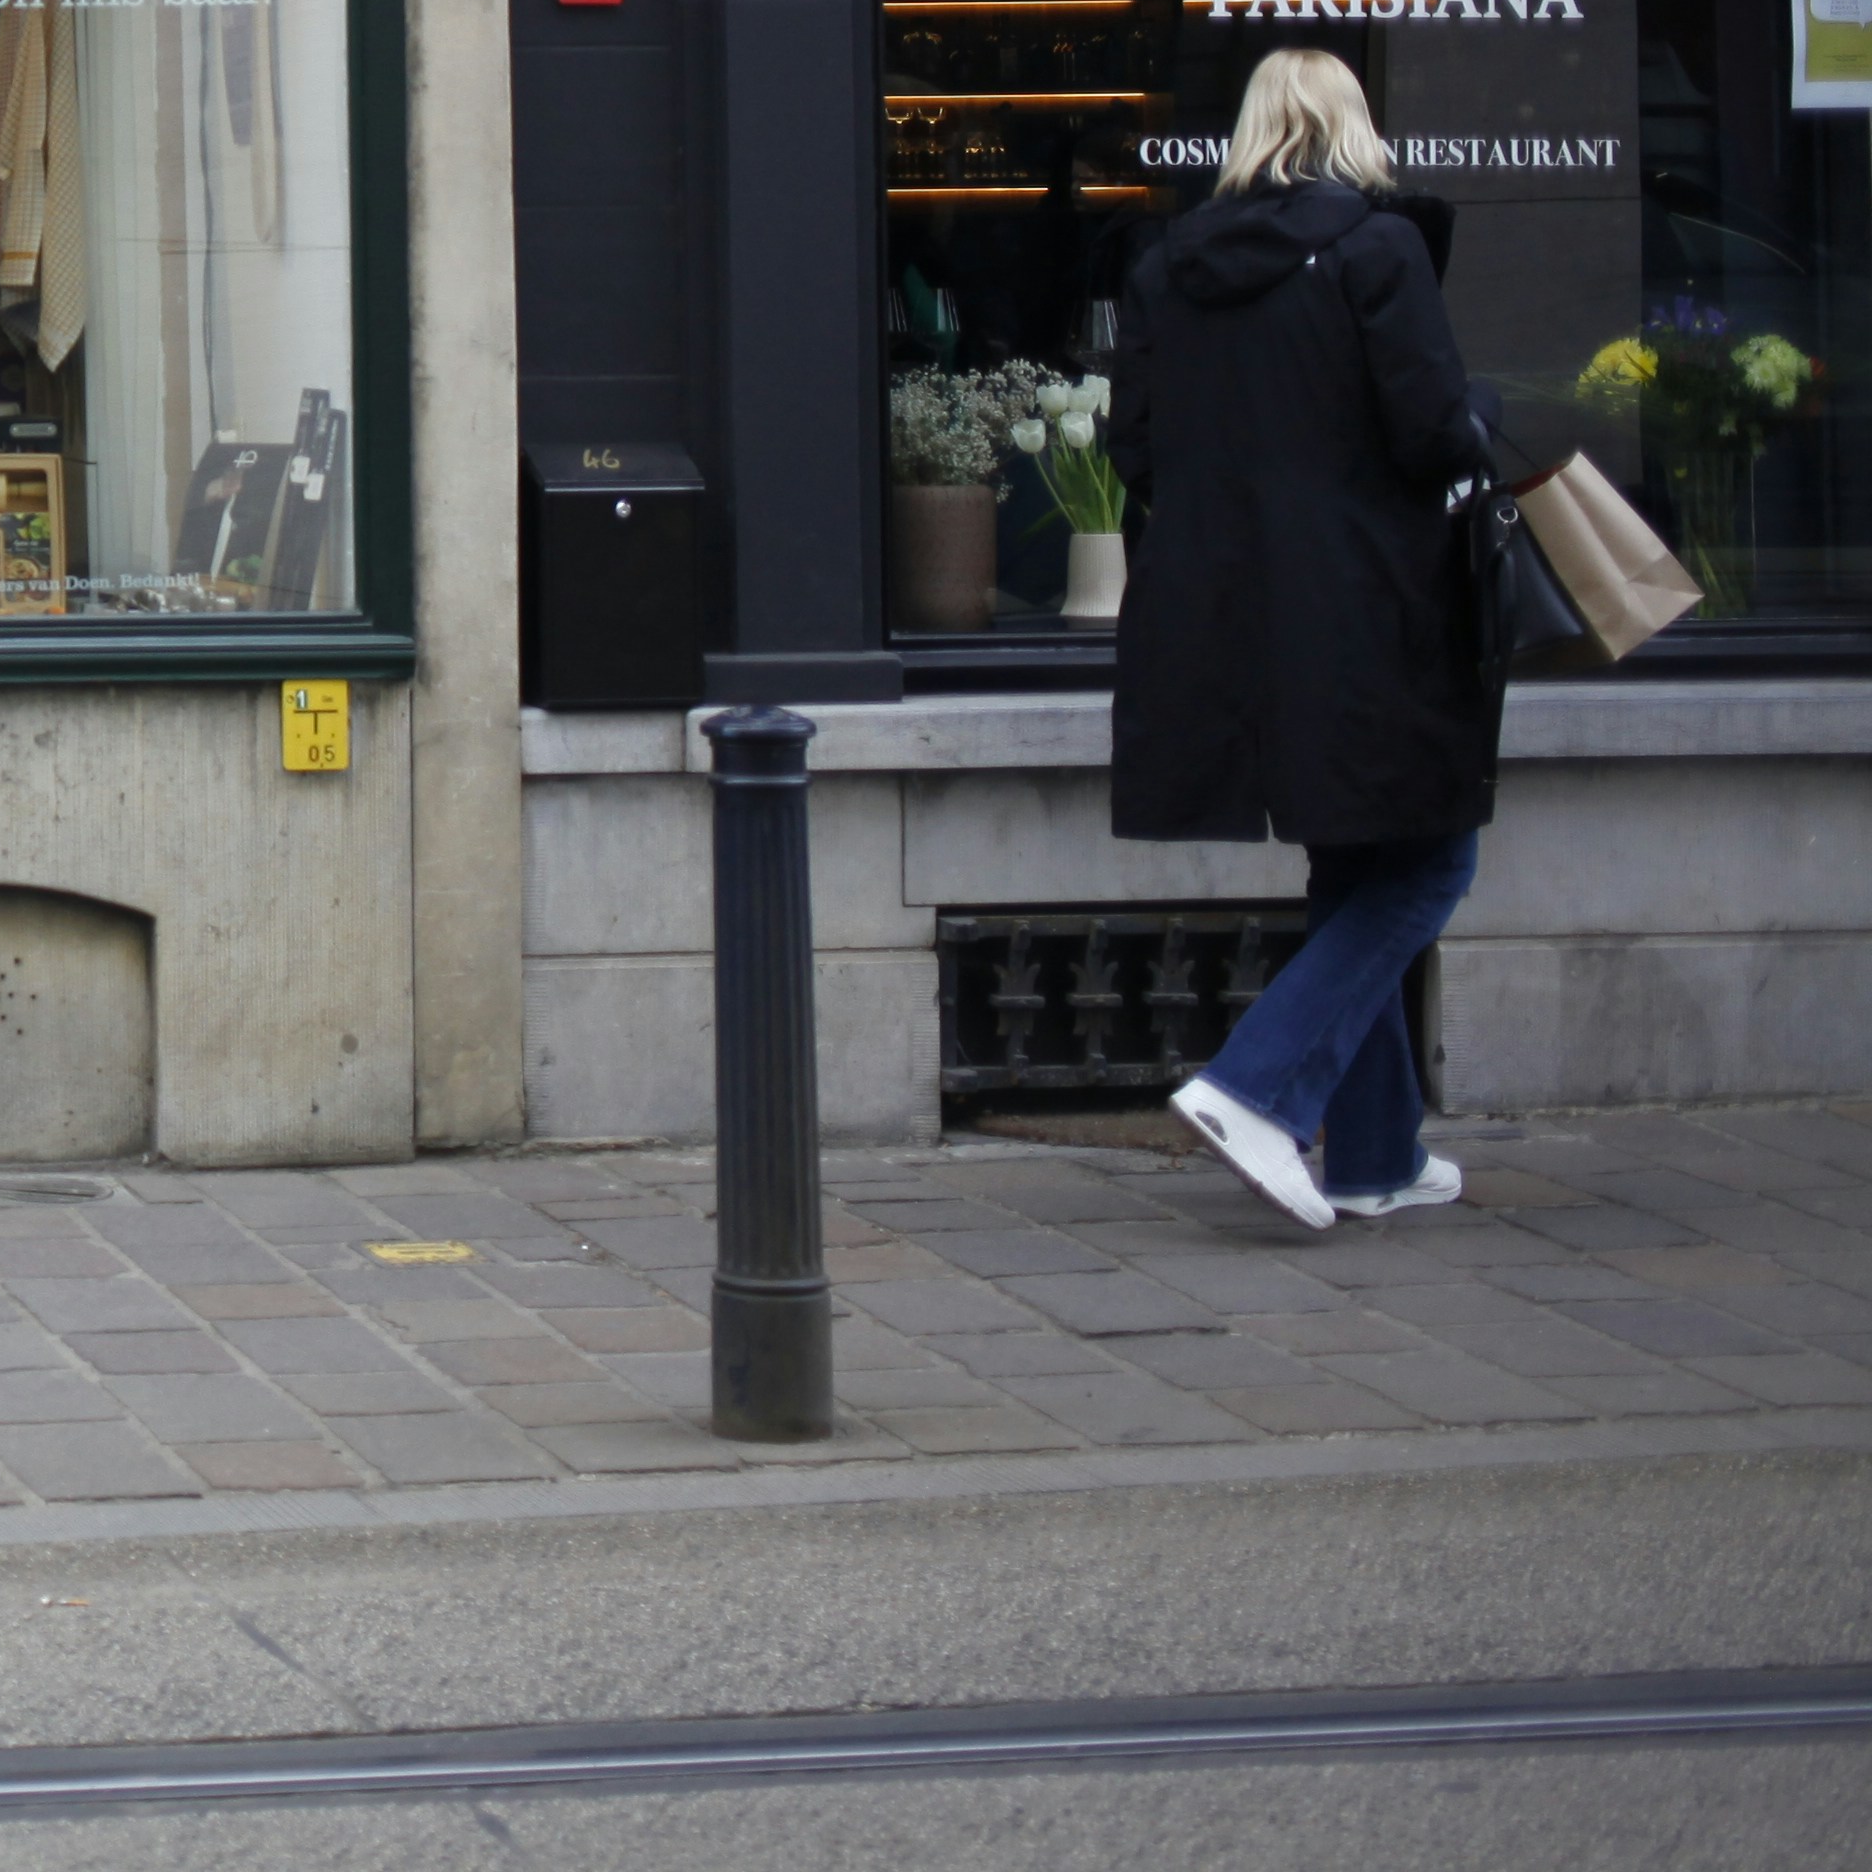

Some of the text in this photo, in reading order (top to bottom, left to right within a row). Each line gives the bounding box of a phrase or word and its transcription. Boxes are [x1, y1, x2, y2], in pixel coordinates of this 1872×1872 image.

[1406, 138, 1621, 167] RESTAURANT
[583, 448, 620, 469] 46
[28, 581, 59, 593] van
[64, 576, 115, 590] Doen.
[120, 572, 200, 588] Bedankt!
[297, 690, 305, 708] 1
